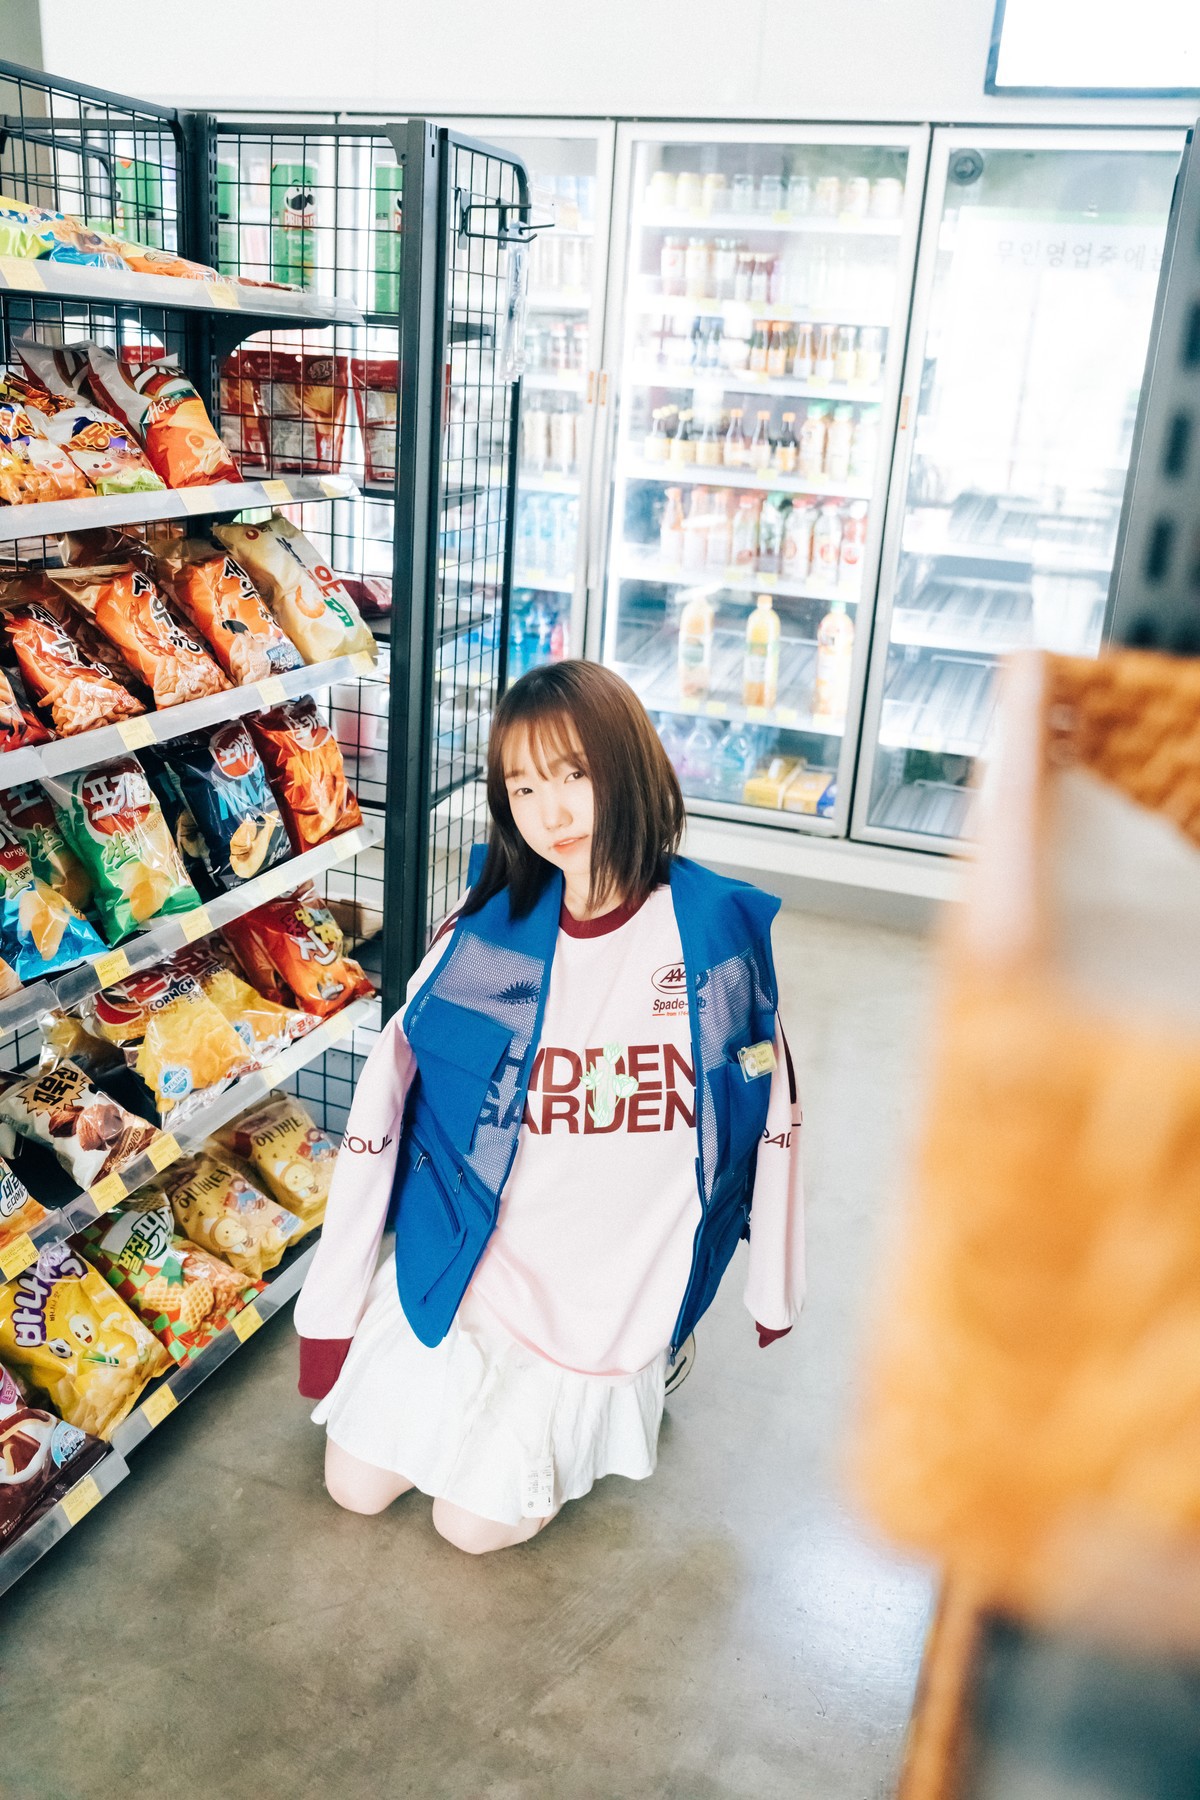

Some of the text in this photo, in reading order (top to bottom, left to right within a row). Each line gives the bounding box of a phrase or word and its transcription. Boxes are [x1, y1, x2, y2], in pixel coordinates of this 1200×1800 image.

[148, 396, 171, 424] Hot
[131, 570, 204, 655] 새우깡
[149, 985, 181, 1013] CORN
[161, 1068, 189, 1094] Original
[177, 1164, 233, 1210] 허니버터
[118, 1235, 150, 1275] 벌집
